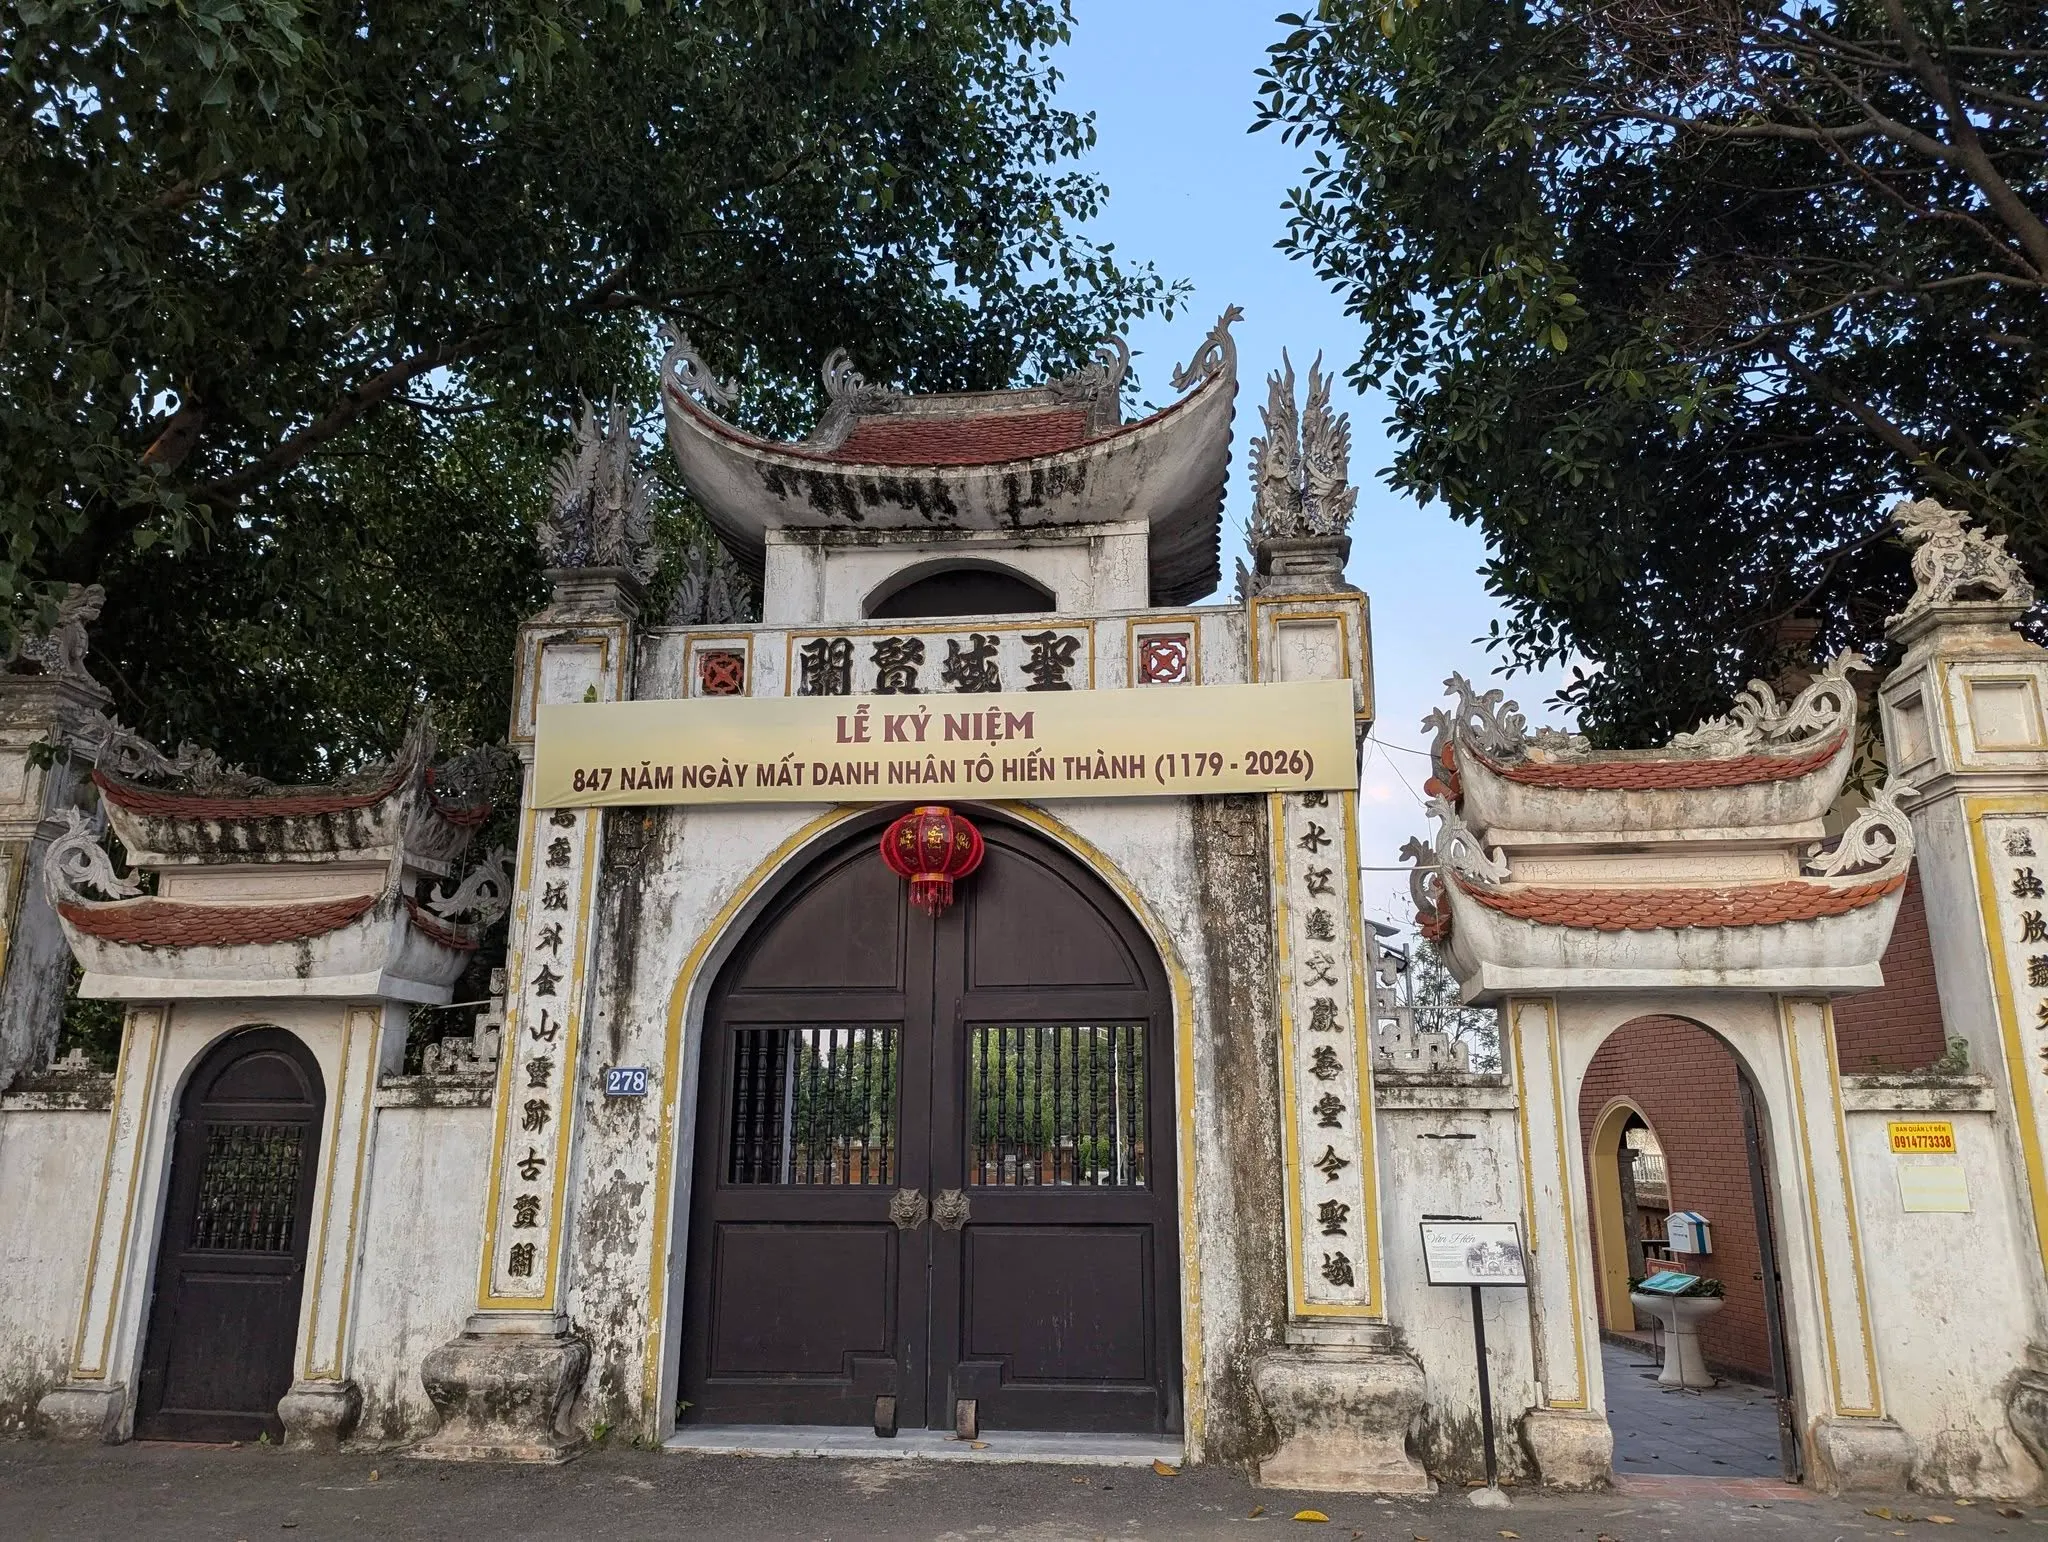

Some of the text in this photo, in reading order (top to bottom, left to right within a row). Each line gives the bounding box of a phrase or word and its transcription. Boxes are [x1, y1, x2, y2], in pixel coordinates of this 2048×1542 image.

[836, 704, 1035, 746] LỄ KỶ NIỆM
[573, 768, 612, 792] 847
[620, 761, 673, 790] NĂM
[682, 757, 748, 788] NGÀY
[756, 752, 805, 787] MẤT
[812, 762, 879, 785] DANH
[888, 753, 955, 784] NHÂN
[963, 752, 994, 782] TÔ
[1002, 747, 1055, 781] HIẾN
[1063, 748, 1145, 780] THÀNH
[1155, 752, 1223, 785] (1179
[1245, 750, 1314, 782] 2026)
[609, 1071, 645, 1091] 278
[1895, 1135, 1952, 1148] 0914773338
